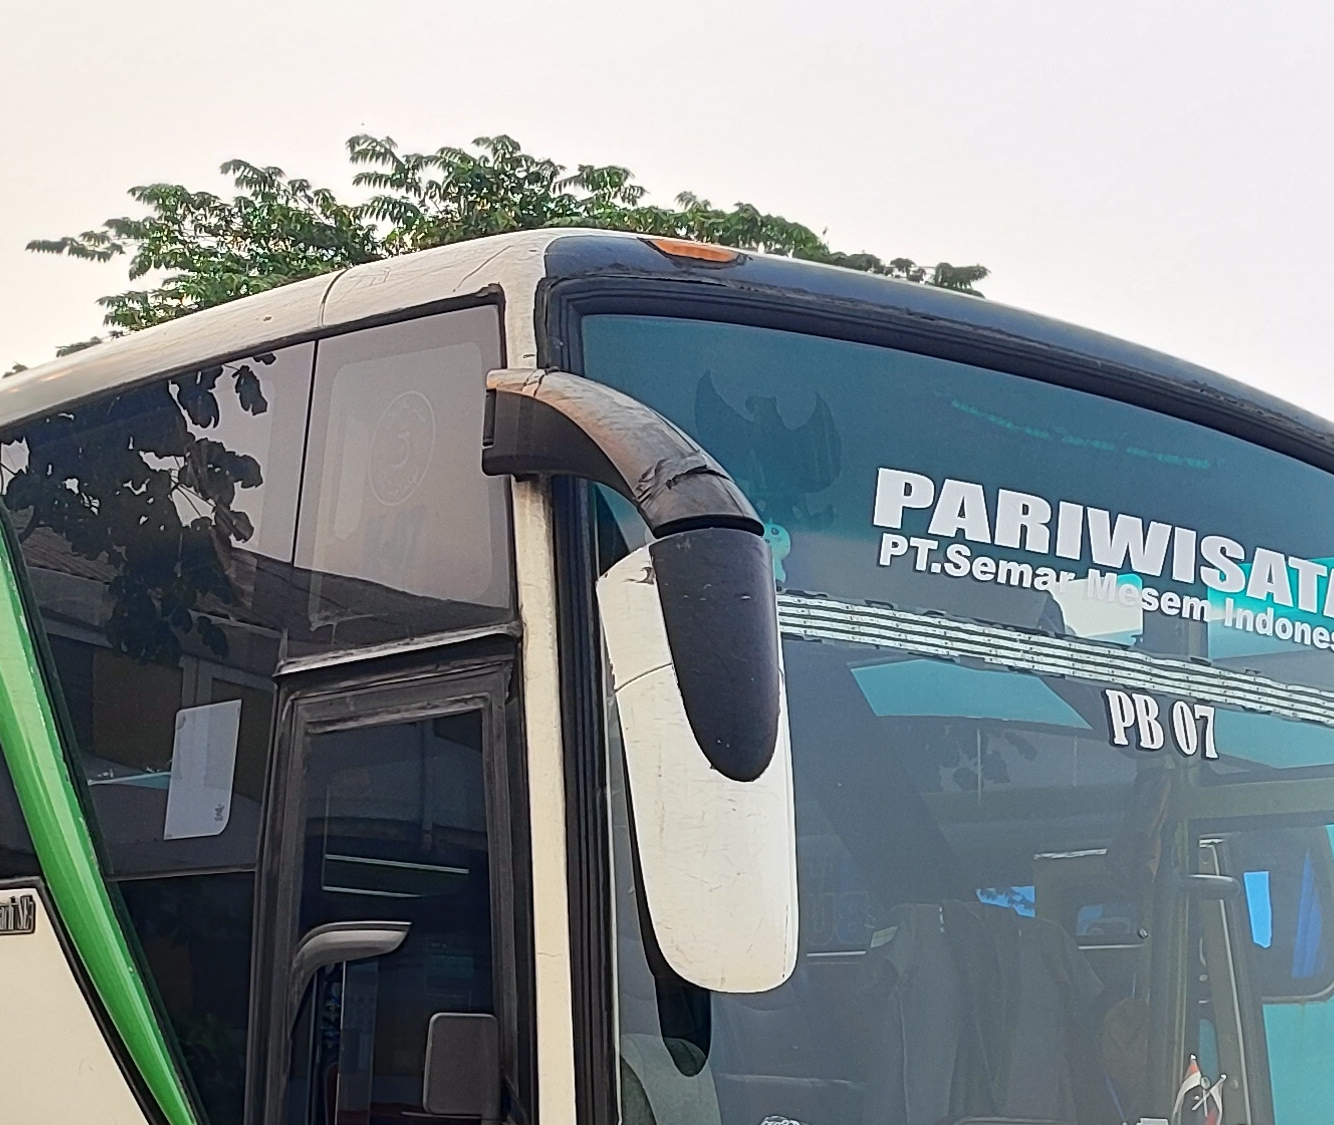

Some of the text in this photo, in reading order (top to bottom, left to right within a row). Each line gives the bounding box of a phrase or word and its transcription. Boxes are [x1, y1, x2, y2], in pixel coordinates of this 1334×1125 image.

[1084, 566, 1212, 624] Mesem
[1103, 687, 1221, 760] PB 07
